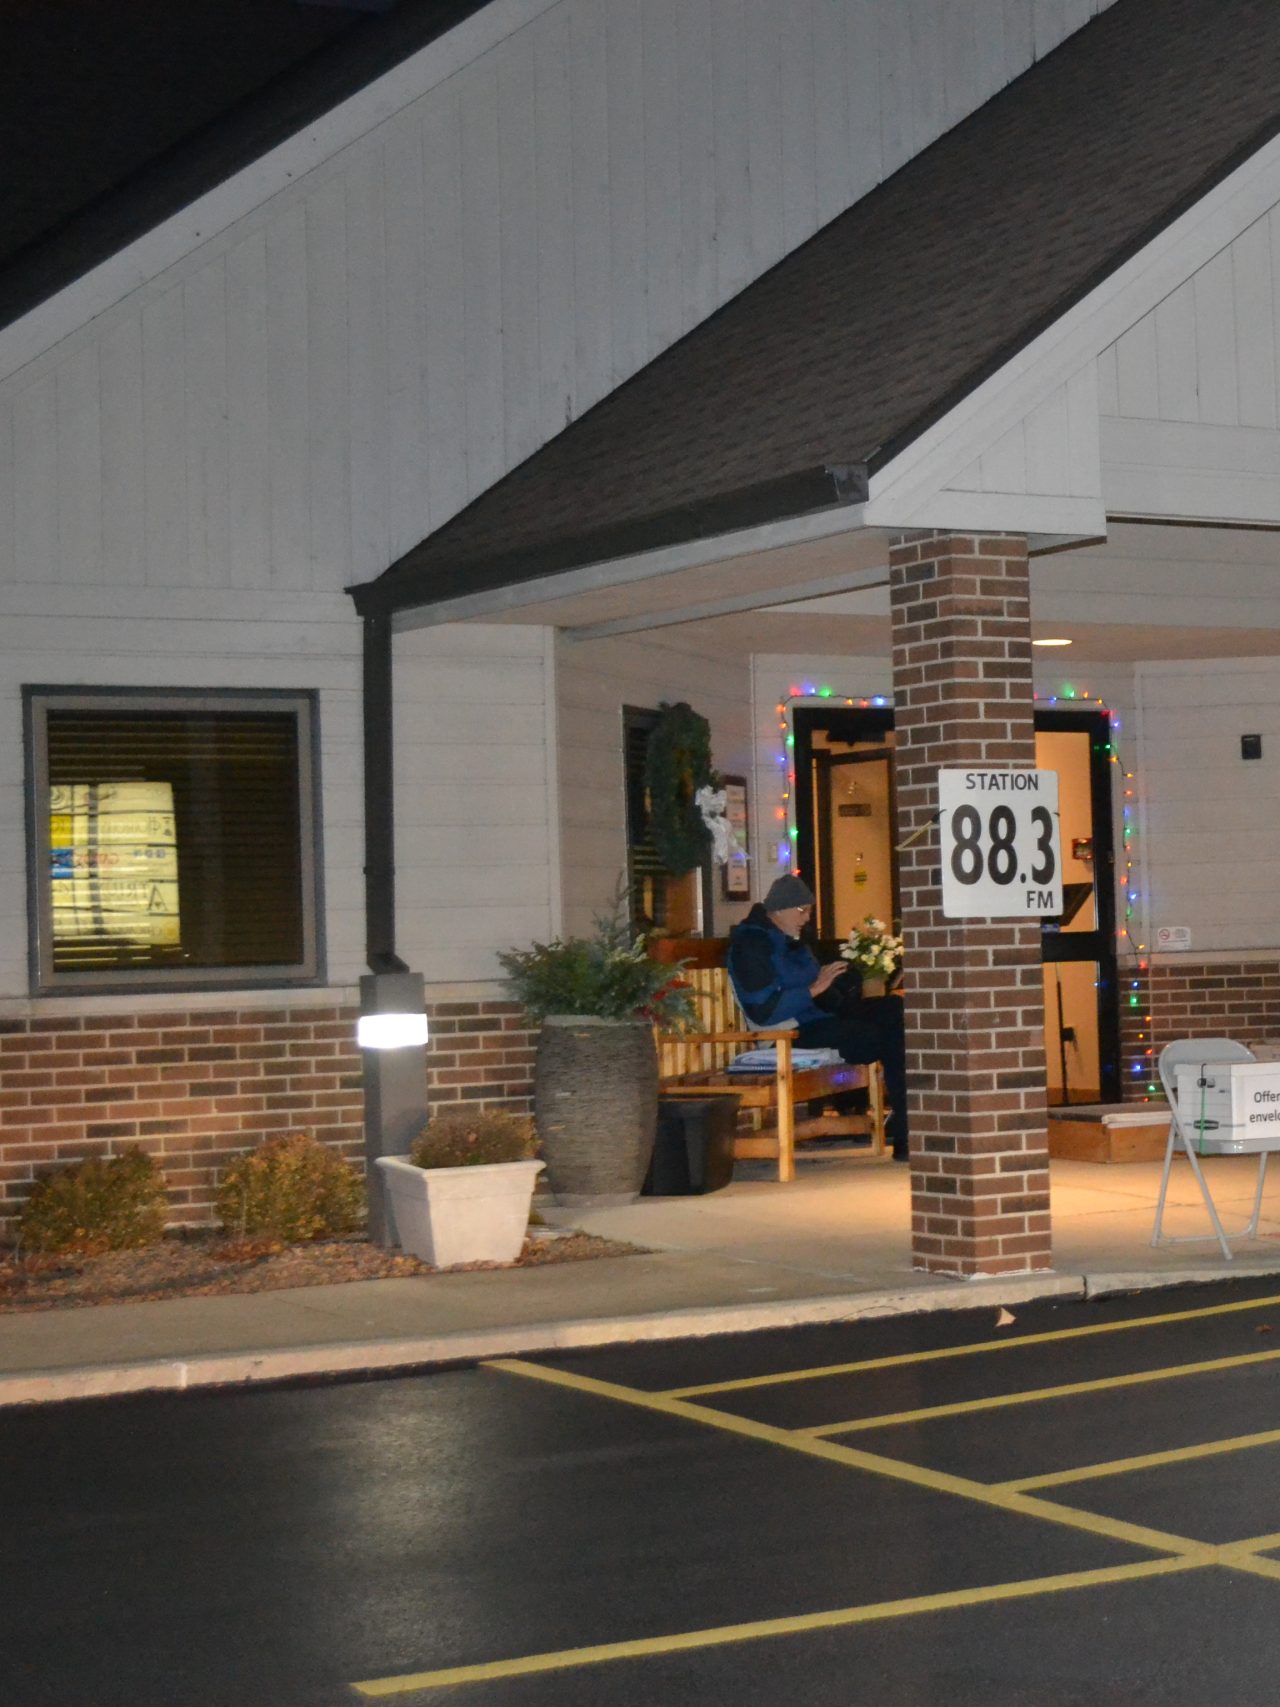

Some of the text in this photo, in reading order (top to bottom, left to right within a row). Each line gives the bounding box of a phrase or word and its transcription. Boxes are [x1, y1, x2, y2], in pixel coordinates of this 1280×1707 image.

[965, 773, 1039, 791] STATION
[951, 804, 1055, 885] 88.3
[1026, 890, 1054, 909] FM
